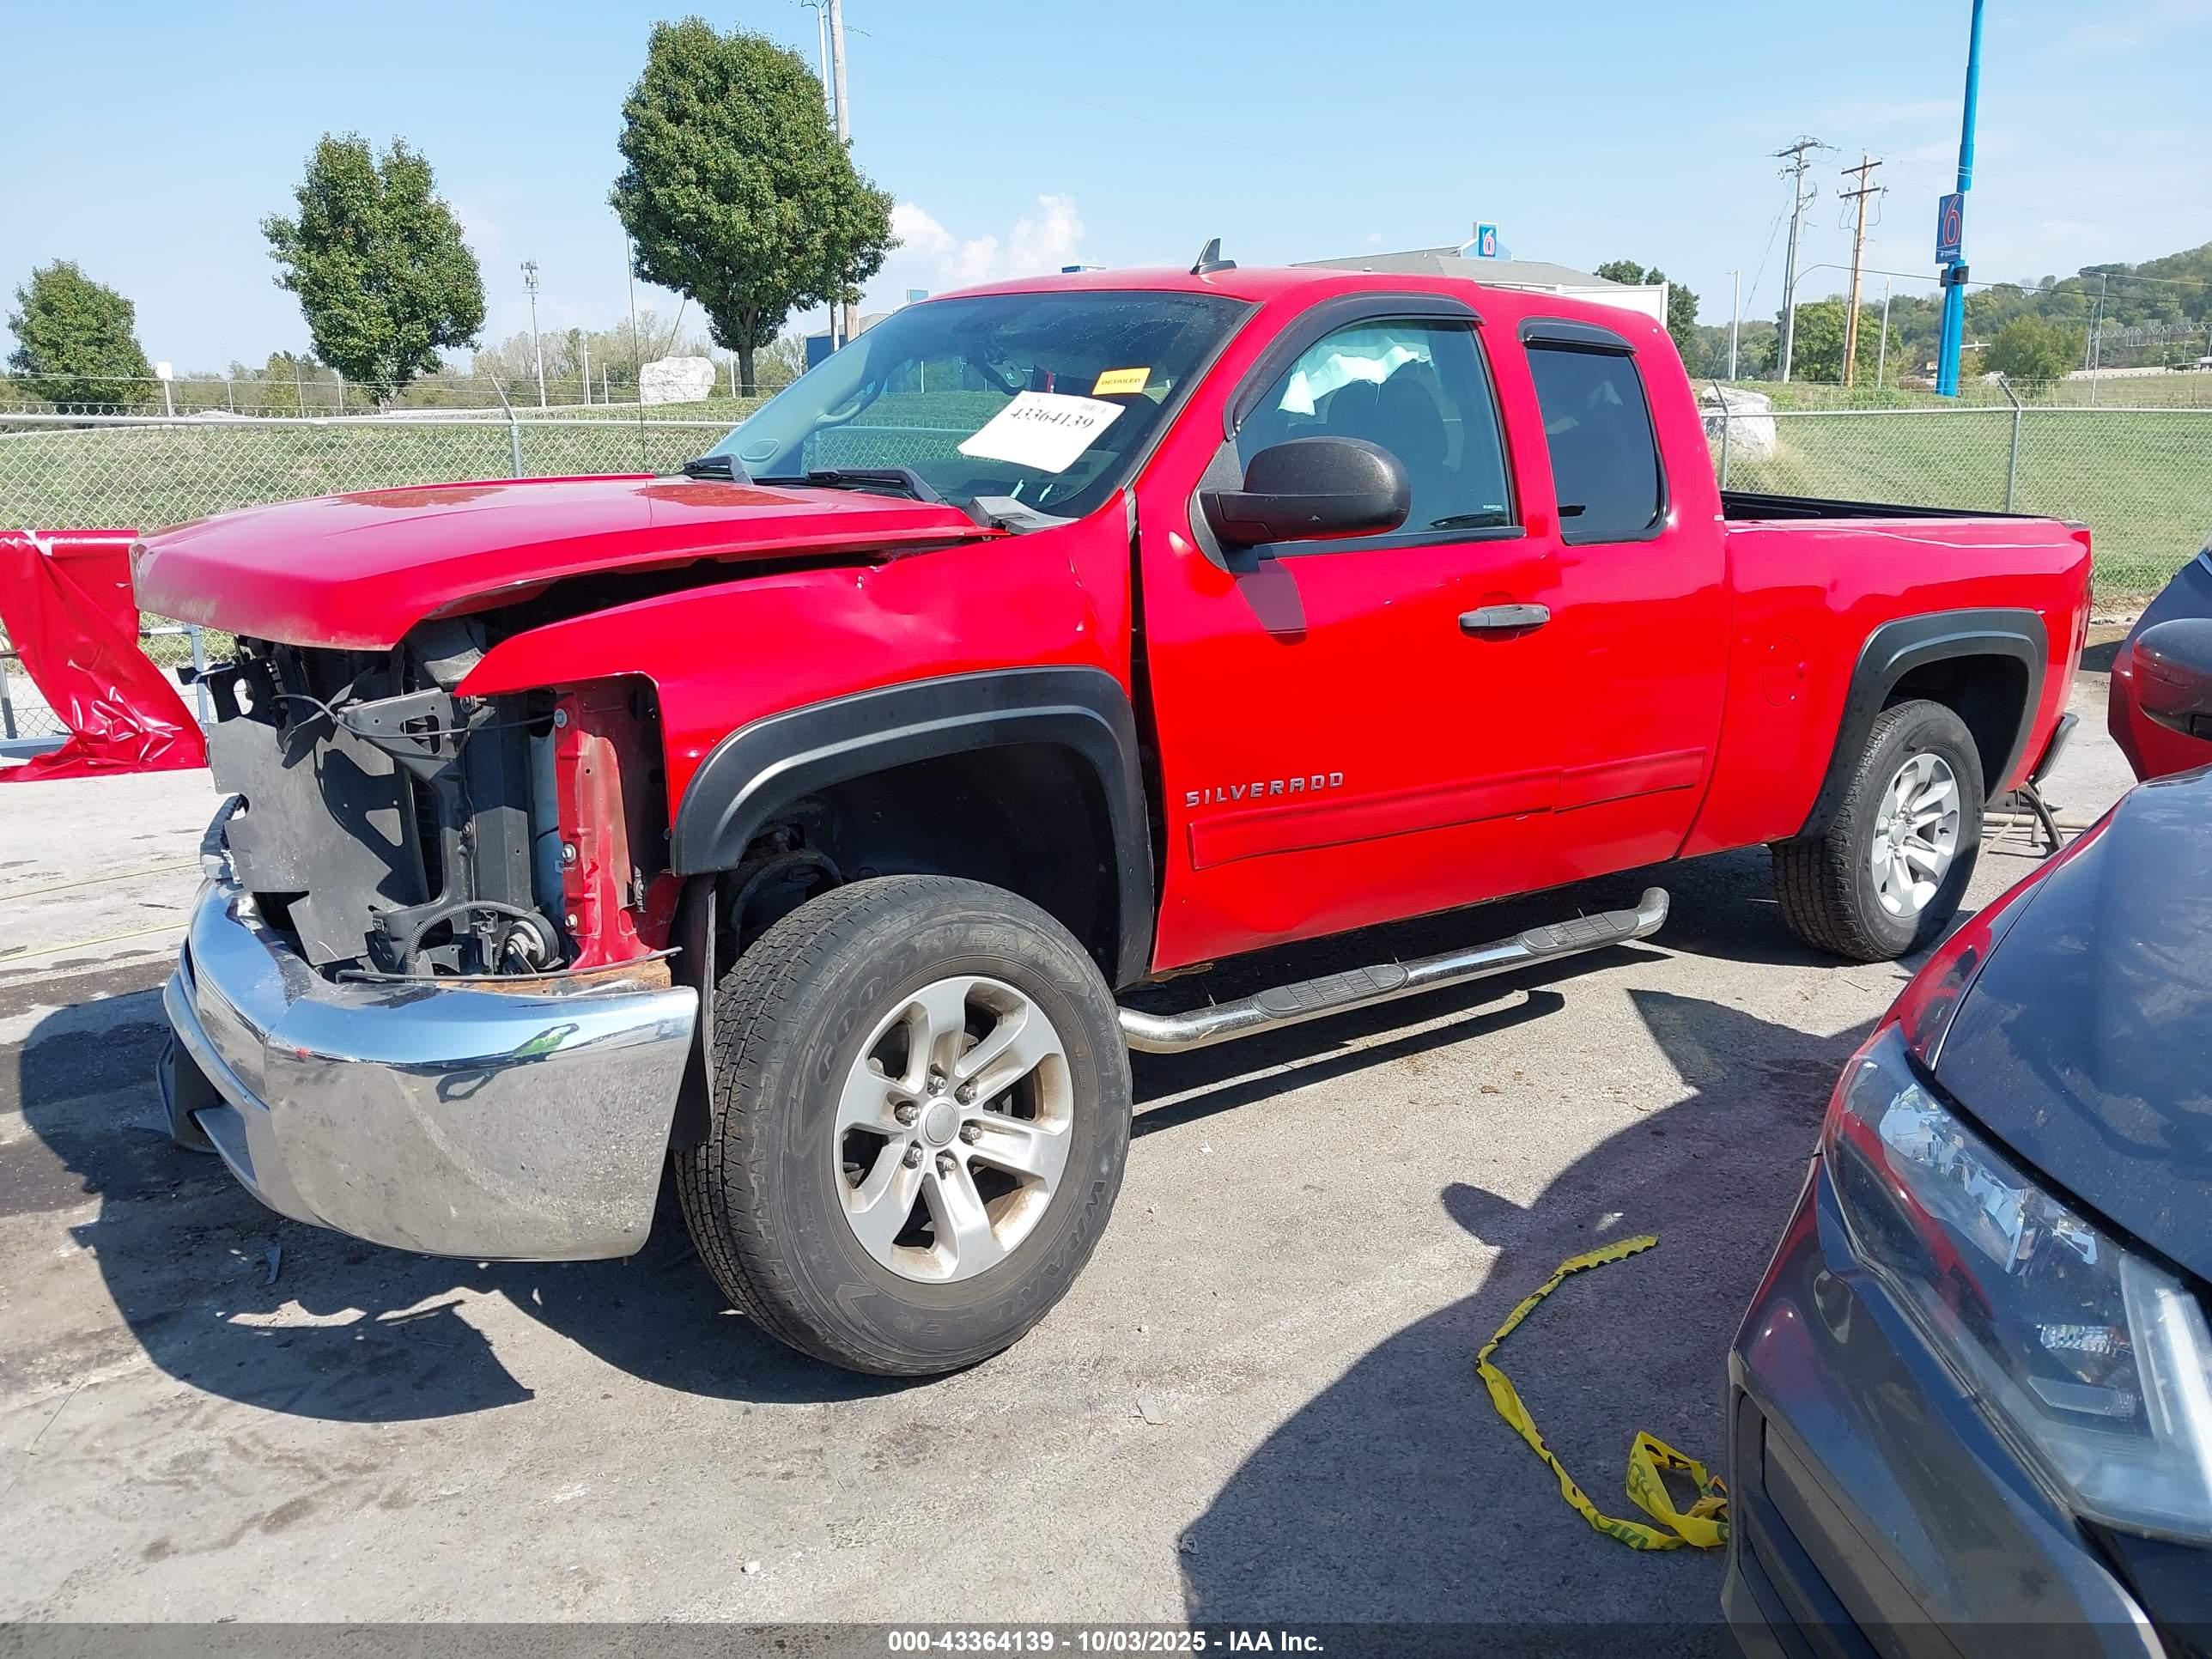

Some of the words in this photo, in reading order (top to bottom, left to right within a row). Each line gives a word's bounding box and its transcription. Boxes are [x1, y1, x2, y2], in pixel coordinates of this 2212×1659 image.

[1943, 195, 1961, 247] 6
[1483, 228, 1495, 256] 6
[1011, 408, 1095, 429] 43364139
[1185, 772, 1344, 808] SILVERADO
